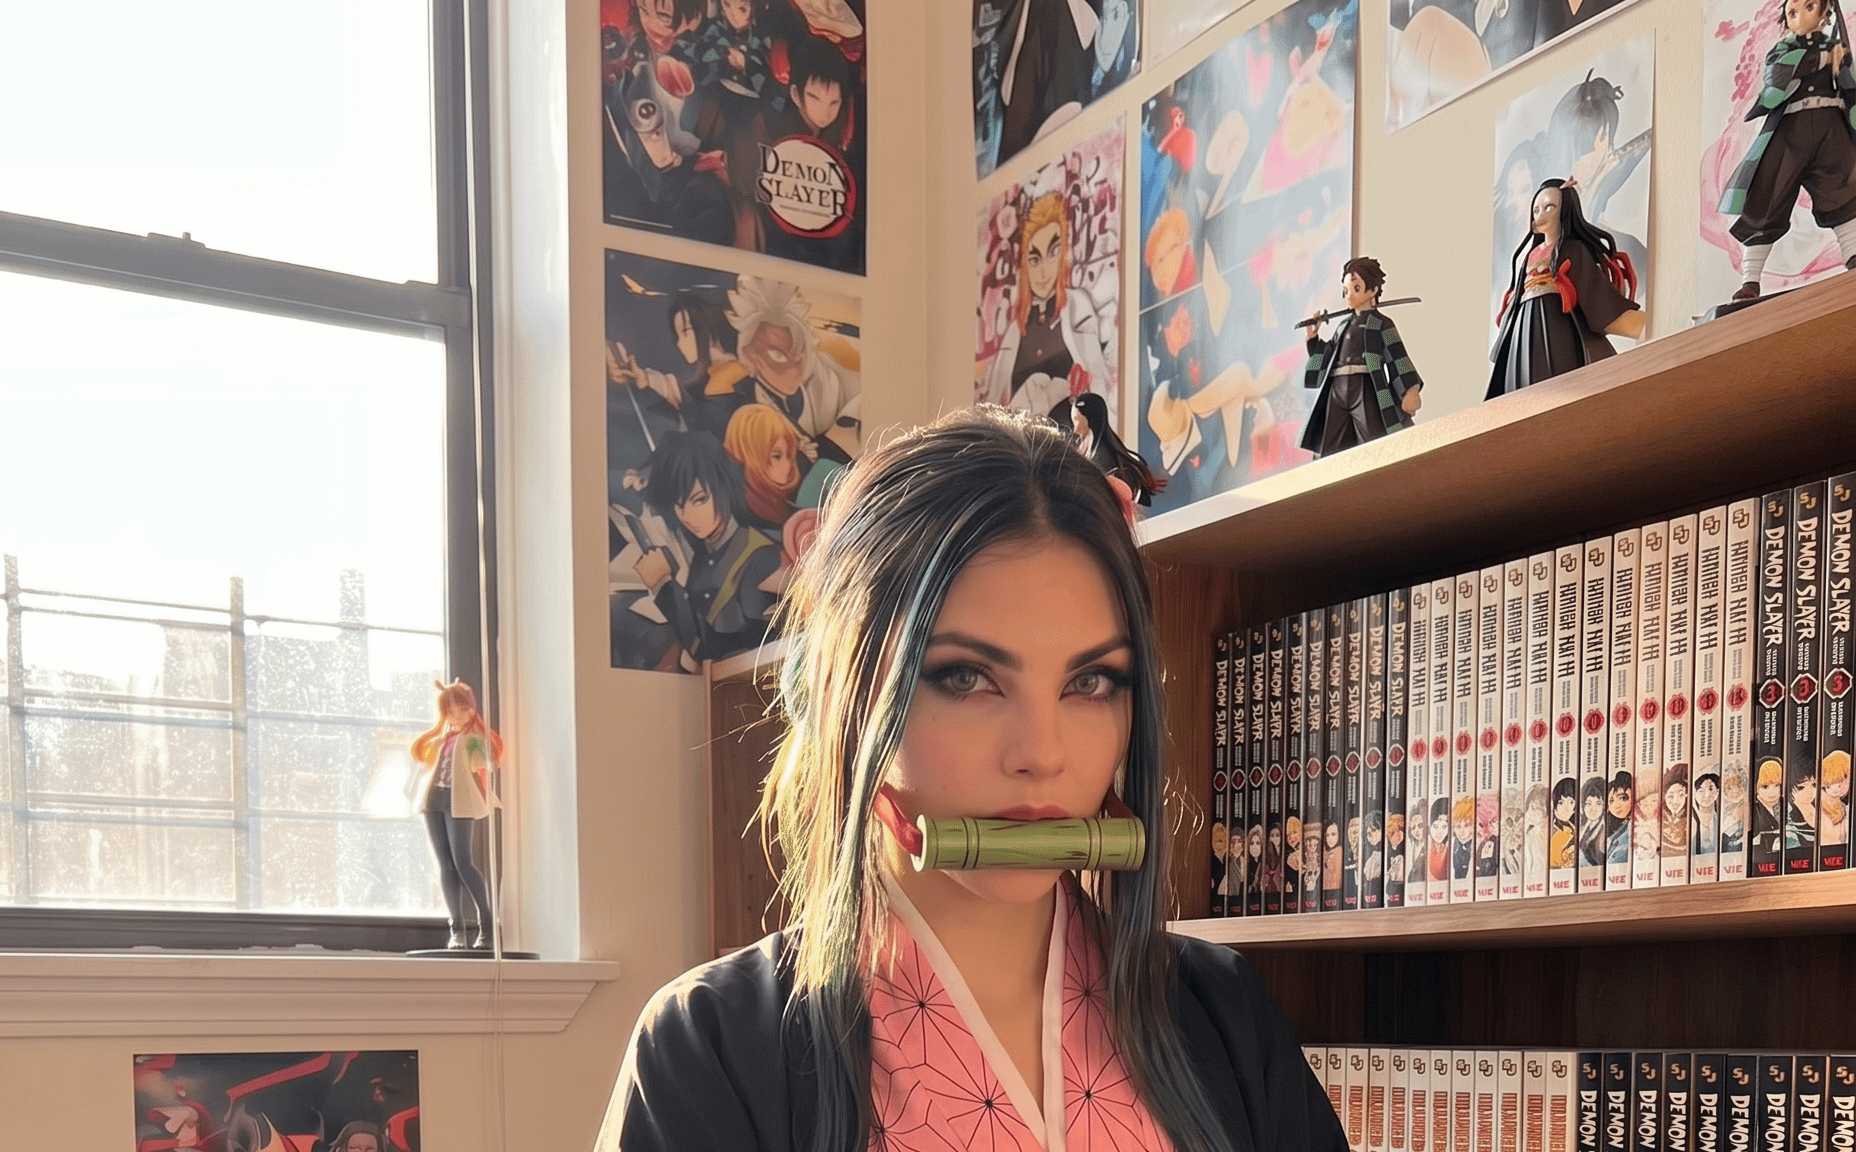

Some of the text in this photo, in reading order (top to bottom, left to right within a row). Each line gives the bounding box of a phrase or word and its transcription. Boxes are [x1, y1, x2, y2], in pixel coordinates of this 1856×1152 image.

[758, 143, 845, 186] DEMON
[757, 176, 848, 217] SLAYER
[1768, 500, 1784, 518] SJ
[1800, 492, 1816, 510] SJ
[1834, 484, 1850, 502] SJ
[1764, 526, 1785, 588] DEMON
[1796, 516, 1818, 580] DEMON
[1831, 508, 1852, 574] DEMON
[1762, 592, 1783, 648] SLAYER
[1794, 584, 1816, 642] SLAYER
[1829, 578, 1850, 636] SLAYER
[1291, 645, 1302, 694] DEMON
[1309, 640, 1322, 690] DEMON
[1329, 636, 1342, 686] DEMON
[1349, 632, 1361, 681] DEMON
[1370, 625, 1384, 676] DEMON
[1392, 622, 1406, 673] DEMON
[1216, 660, 1228, 706] DEMON
[1234, 657, 1245, 704] DEMON
[1252, 652, 1264, 700] DEMON
[1270, 649, 1282, 696] DEMON
[1582, 1063, 1596, 1079] SJ
[1610, 1064, 1624, 1080] SJ
[1641, 1062, 1656, 1080] SJ
[1671, 1064, 1686, 1080] SJ
[1701, 1066, 1716, 1083] SJ
[1732, 1068, 1749, 1085] SJ
[1769, 1065, 1785, 1082] SJ
[1802, 1064, 1820, 1084] SJ
[1836, 1066, 1855, 1085] SJ
[1579, 1090, 1598, 1146] DEMON
[1606, 1090, 1626, 1148] DEMON
[1638, 1090, 1657, 1148] DEMON
[1668, 1092, 1687, 1151] DEMON
